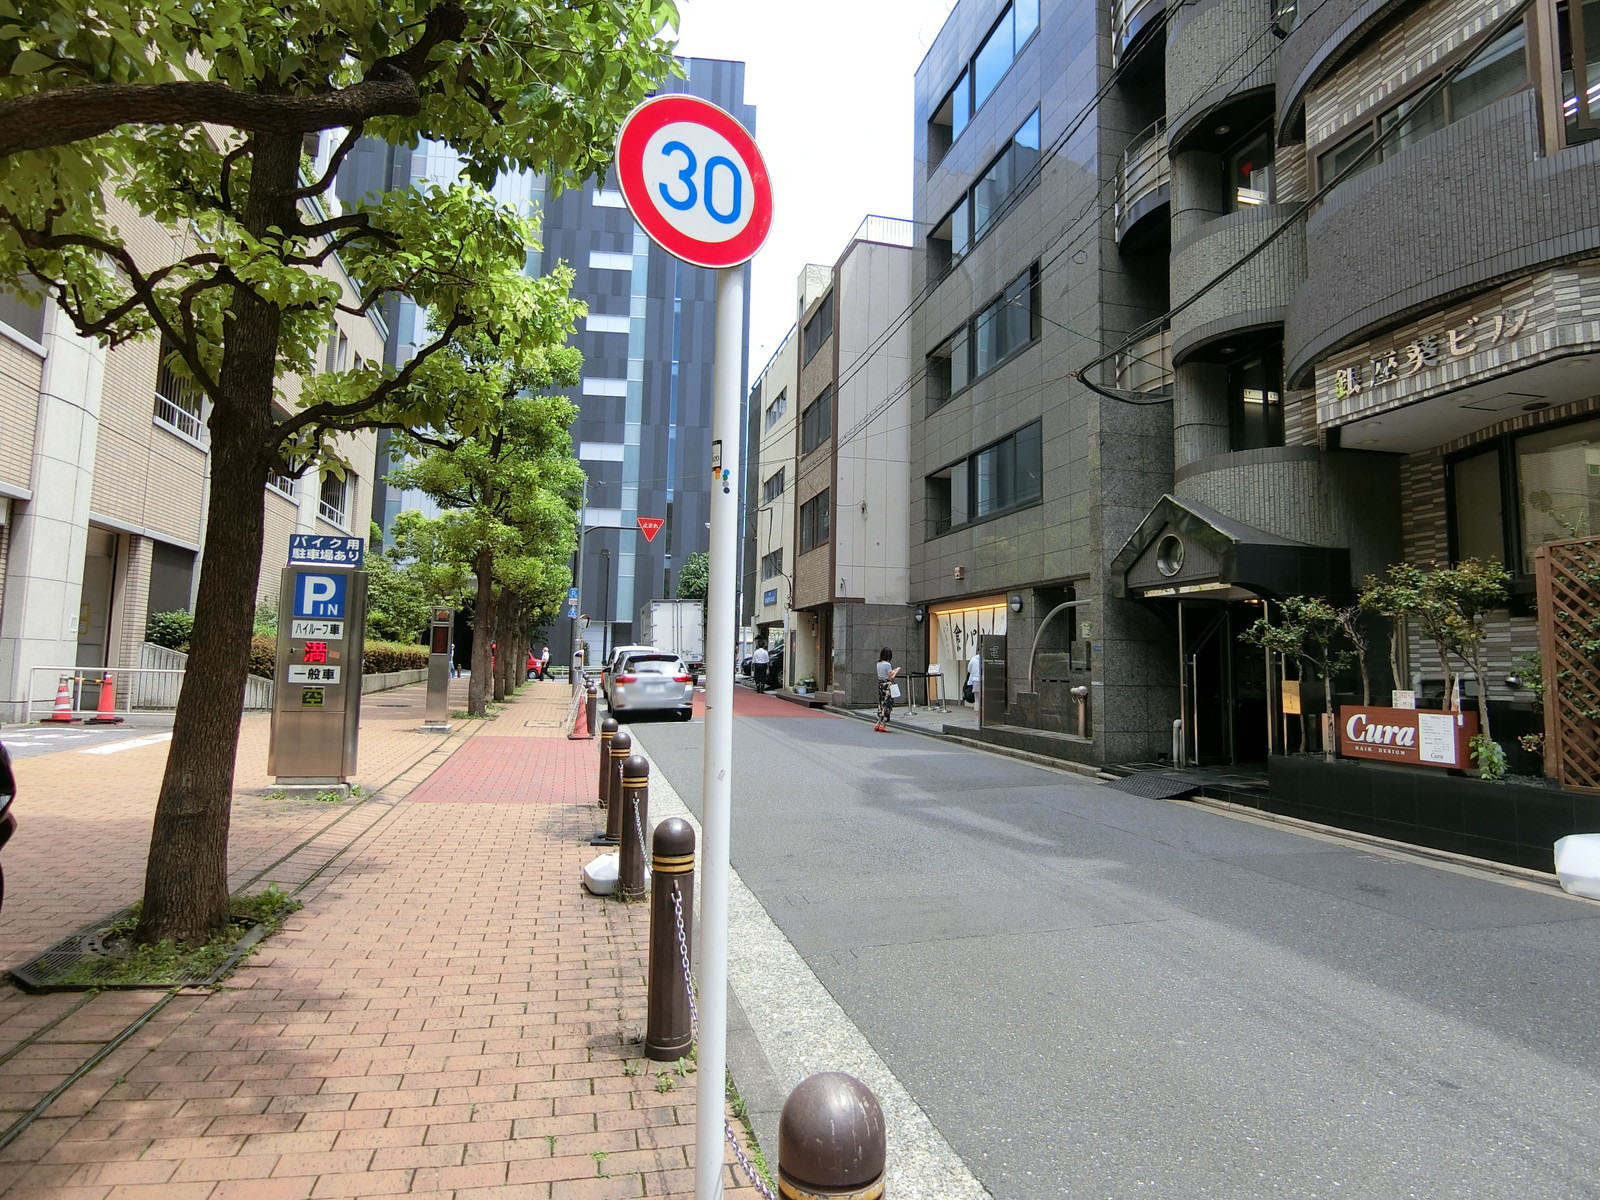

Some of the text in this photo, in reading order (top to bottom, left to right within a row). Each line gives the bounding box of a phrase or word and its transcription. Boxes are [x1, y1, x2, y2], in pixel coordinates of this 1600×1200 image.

[659, 141, 742, 224] 30
[293, 536, 360, 550] バイク用
[292, 548, 360, 562] 駐車場あり
[303, 575, 338, 616] P IN
[295, 623, 340, 636] ハイルーフ車
[304, 641, 327, 663] 満
[294, 668, 335, 681] 一般車
[1346, 714, 1415, 746] Cura
